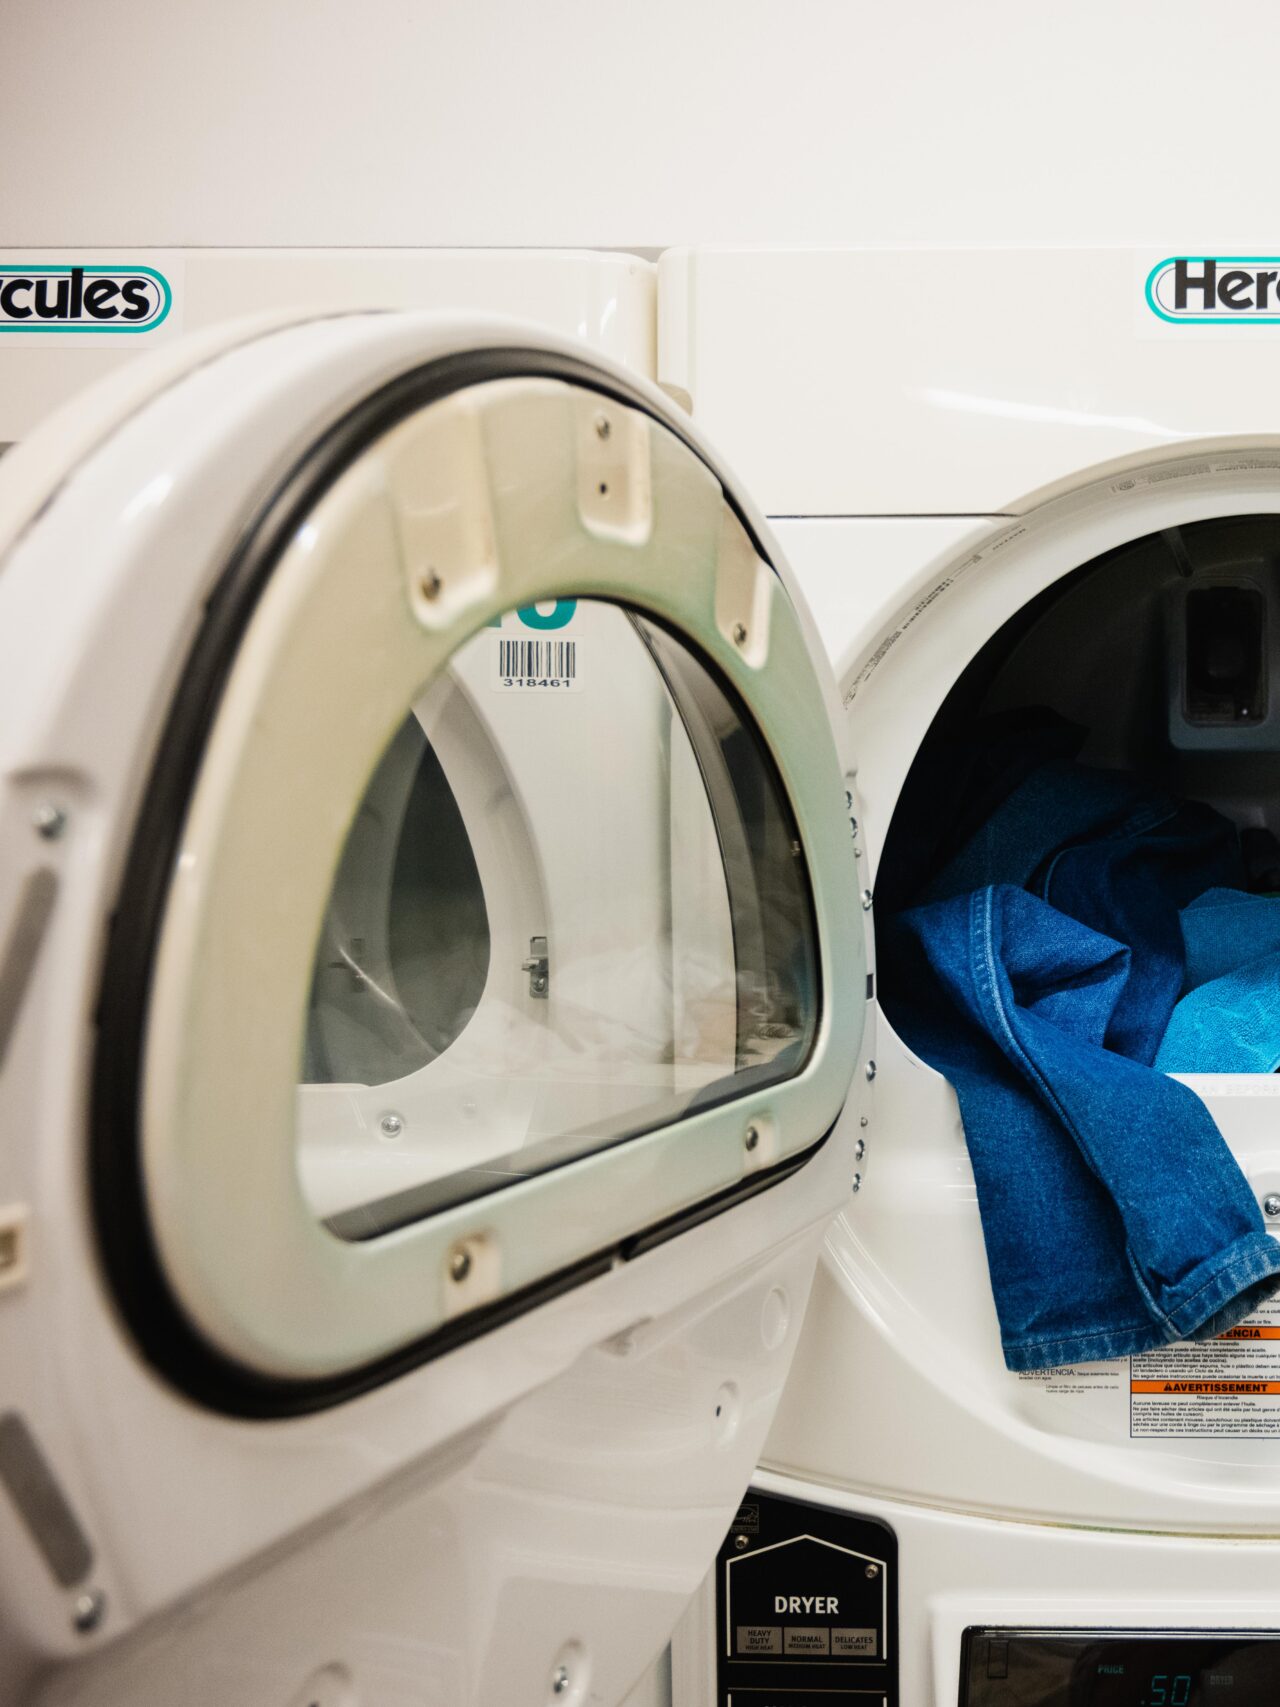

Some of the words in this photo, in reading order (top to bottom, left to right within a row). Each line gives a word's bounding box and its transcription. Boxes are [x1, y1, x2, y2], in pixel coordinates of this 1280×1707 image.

[0, 268, 150, 320] cules
[503, 678, 571, 687] 318461
[1174, 1383, 1268, 1392] AVERTISSEMENT
[774, 1596, 840, 1614] DRYER
[1098, 1664, 1124, 1674] PRICE
